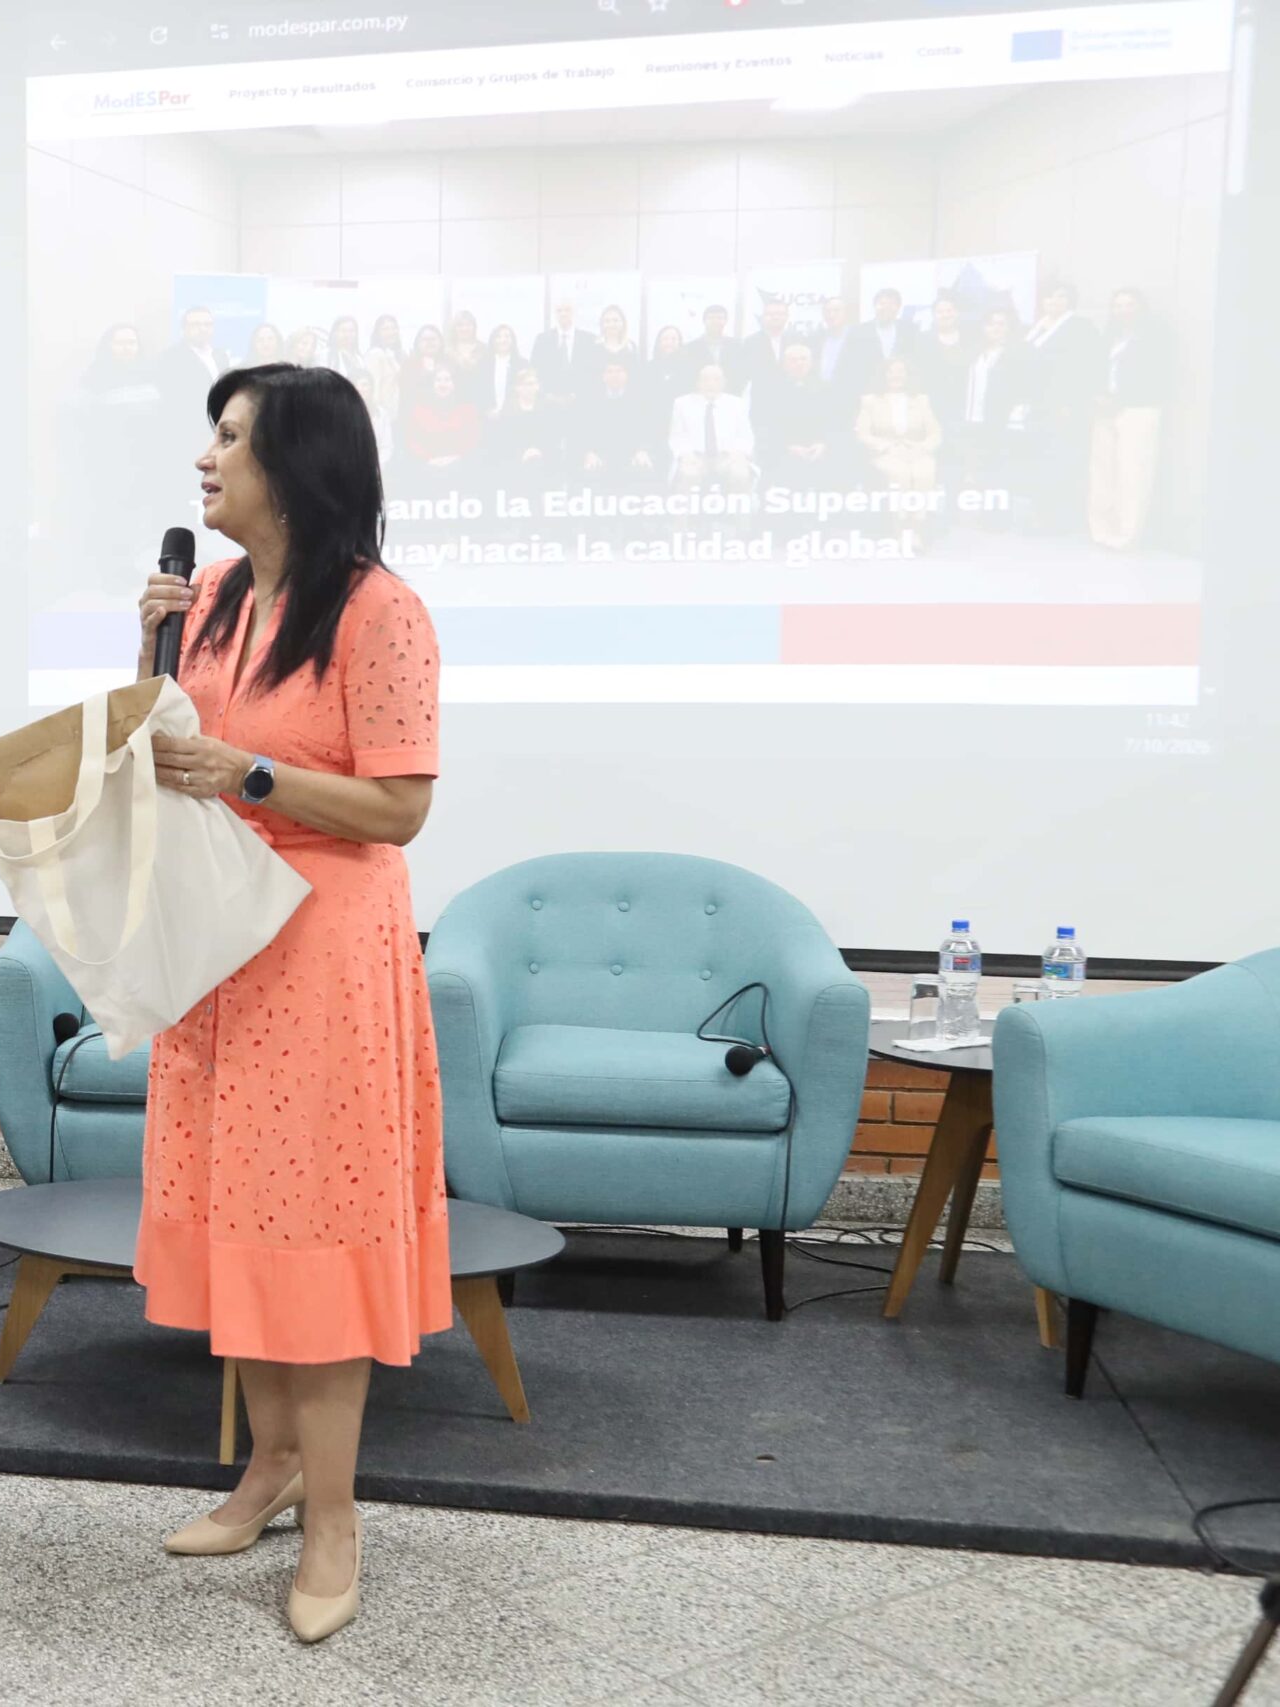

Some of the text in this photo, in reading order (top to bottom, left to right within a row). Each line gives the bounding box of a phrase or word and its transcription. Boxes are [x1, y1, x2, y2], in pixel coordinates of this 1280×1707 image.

[248, 13, 408, 40] modespar.com.py
[735, 55, 792, 69] Eventos
[406, 75, 473, 88] Consorcio
[489, 71, 538, 86] Grupos
[542, 68, 558, 80] de
[564, 65, 615, 79] Trabajo
[93, 89, 192, 110] ModESPar
[229, 86, 288, 100] Proyecto
[302, 81, 376, 94] Resultados
[496, 489, 531, 518] la
[544, 484, 751, 518] Educación
[764, 484, 946, 522] Superior
[957, 486, 1010, 513] en
[460, 534, 566, 565] hacia
[577, 533, 616, 563] la
[624, 531, 773, 562] calidad
[785, 529, 917, 569] global
